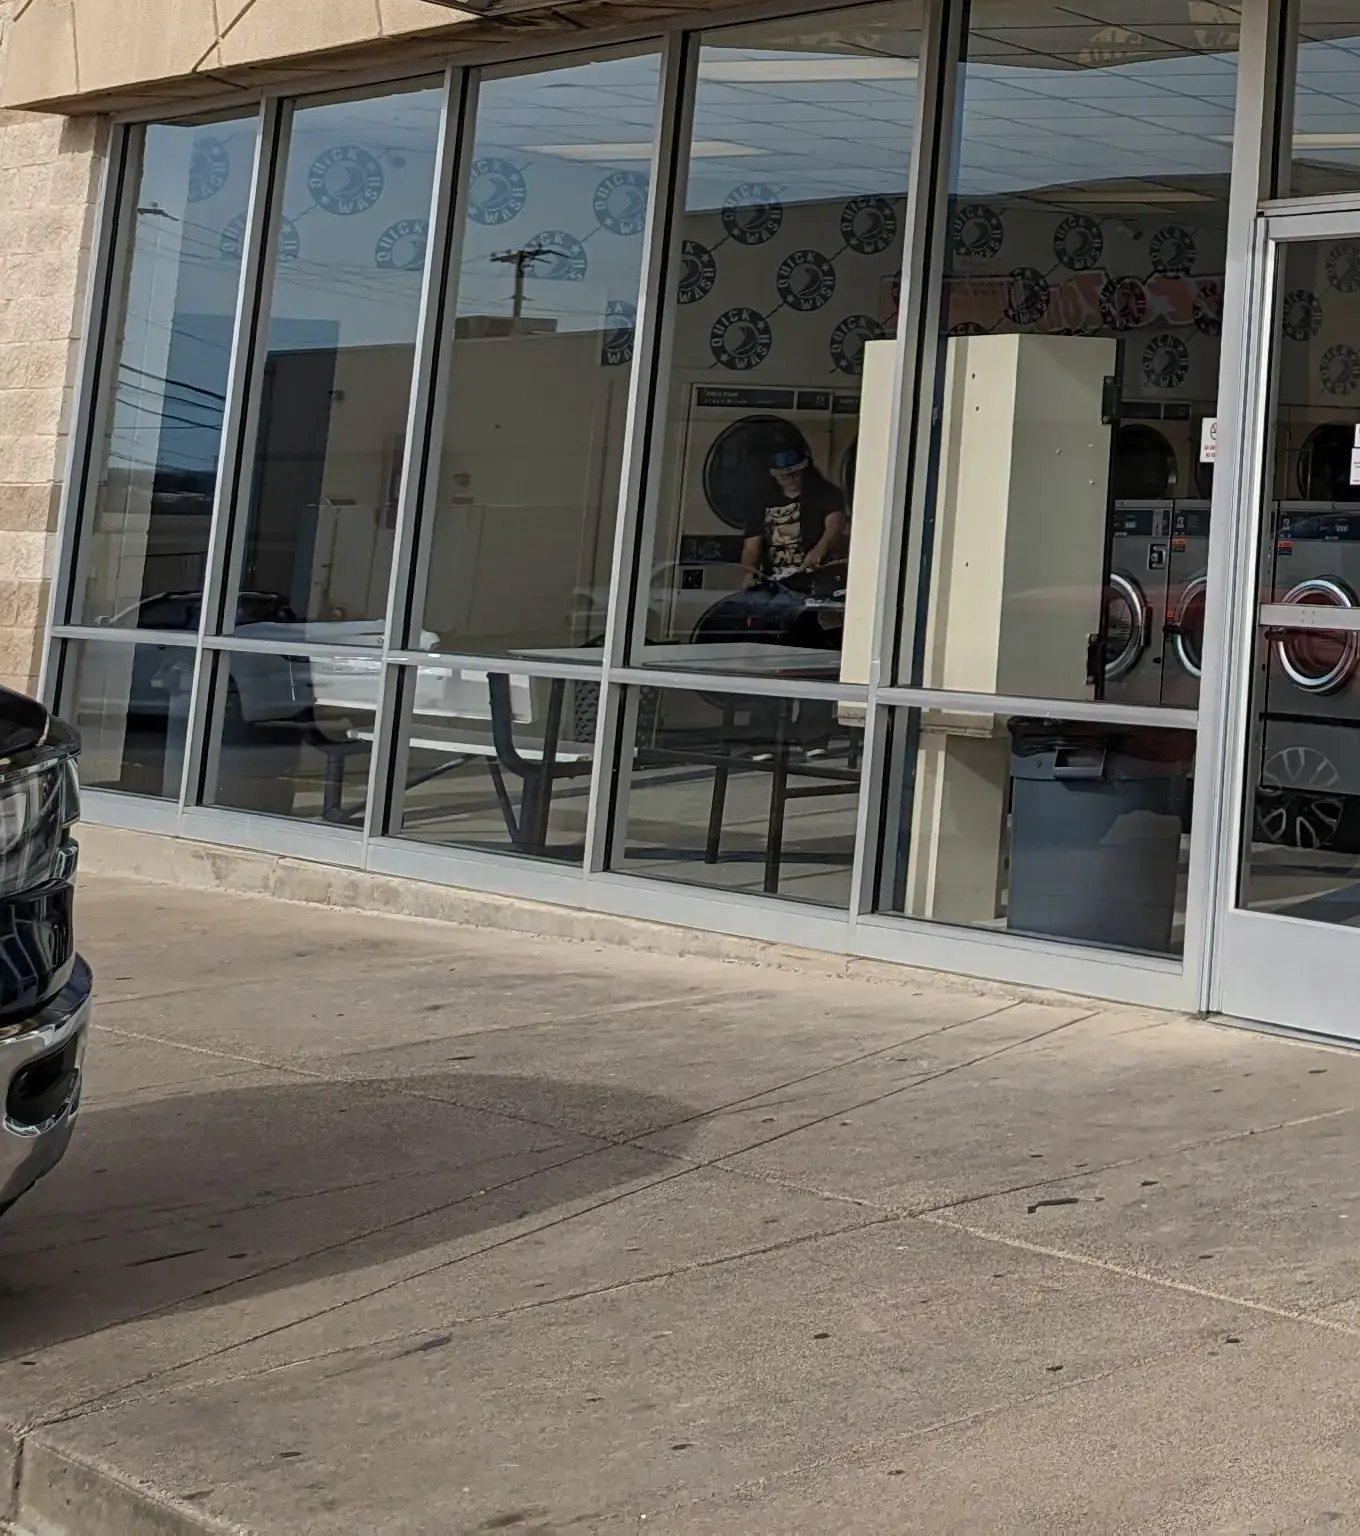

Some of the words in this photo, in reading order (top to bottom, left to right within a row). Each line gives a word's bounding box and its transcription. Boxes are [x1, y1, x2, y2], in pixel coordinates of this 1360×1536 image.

[339, 176, 382, 213] WASH
[722, 184, 762, 221] QUICK
[841, 194, 877, 231] QUICK
[745, 210, 783, 244] WASH
[777, 251, 817, 288] QUICK
[800, 277, 835, 311] WASH
[711, 308, 753, 347] QUICK
[734, 334, 771, 370] WASH
